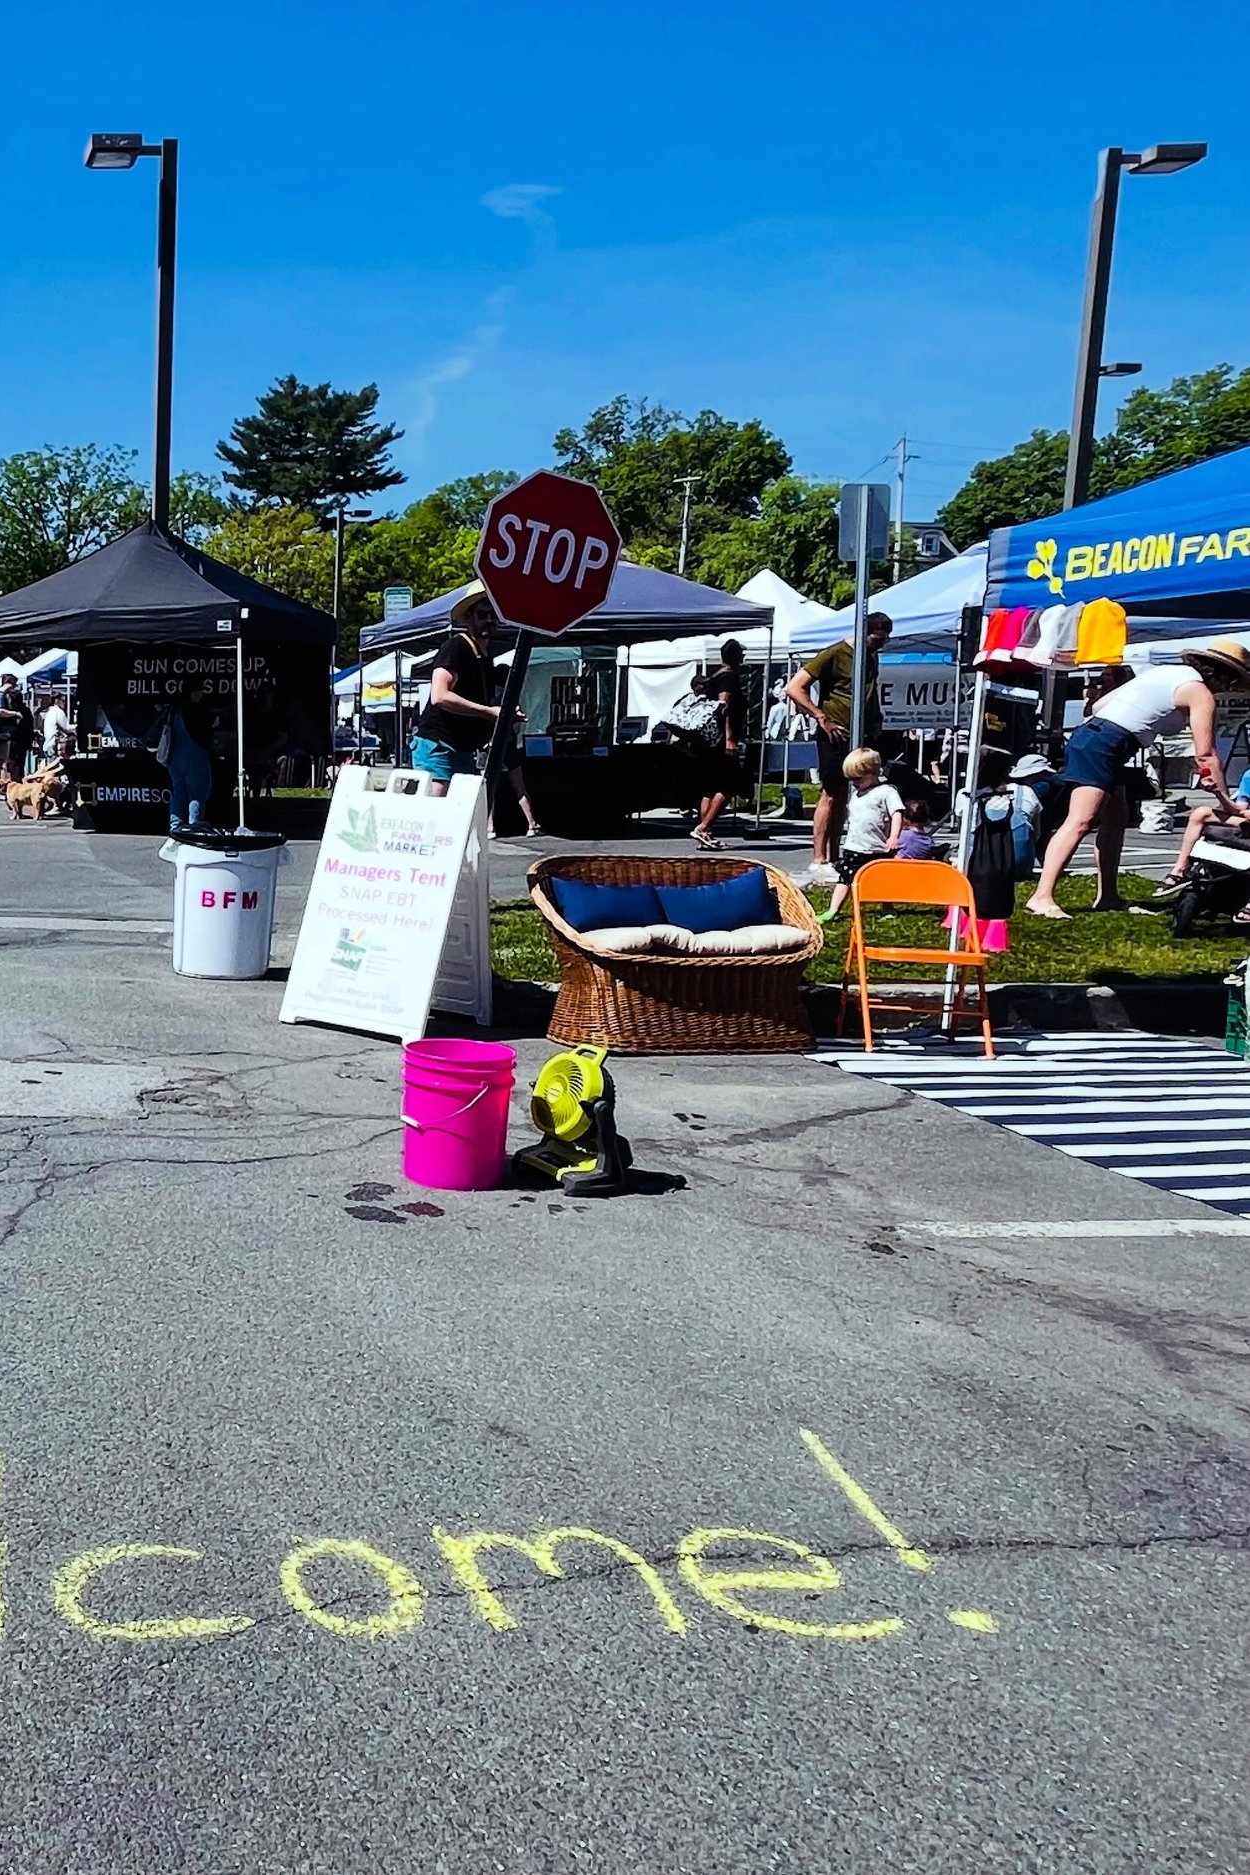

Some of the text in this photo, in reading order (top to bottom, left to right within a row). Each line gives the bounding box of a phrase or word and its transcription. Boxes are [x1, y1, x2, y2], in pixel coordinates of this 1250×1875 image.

[488, 513, 609, 589] STOP
[1064, 531, 1176, 583] BEACON
[132, 658, 168, 675] SUN
[172, 657, 236, 675] COMES
[126, 679, 160, 695] BILL
[380, 817, 425, 832] BEACON
[382, 840, 439, 858] MARKET
[323, 857, 448, 889] Managers Tent
[339, 884, 418, 908] SNAP EBT
[316, 901, 388, 926] Processed
